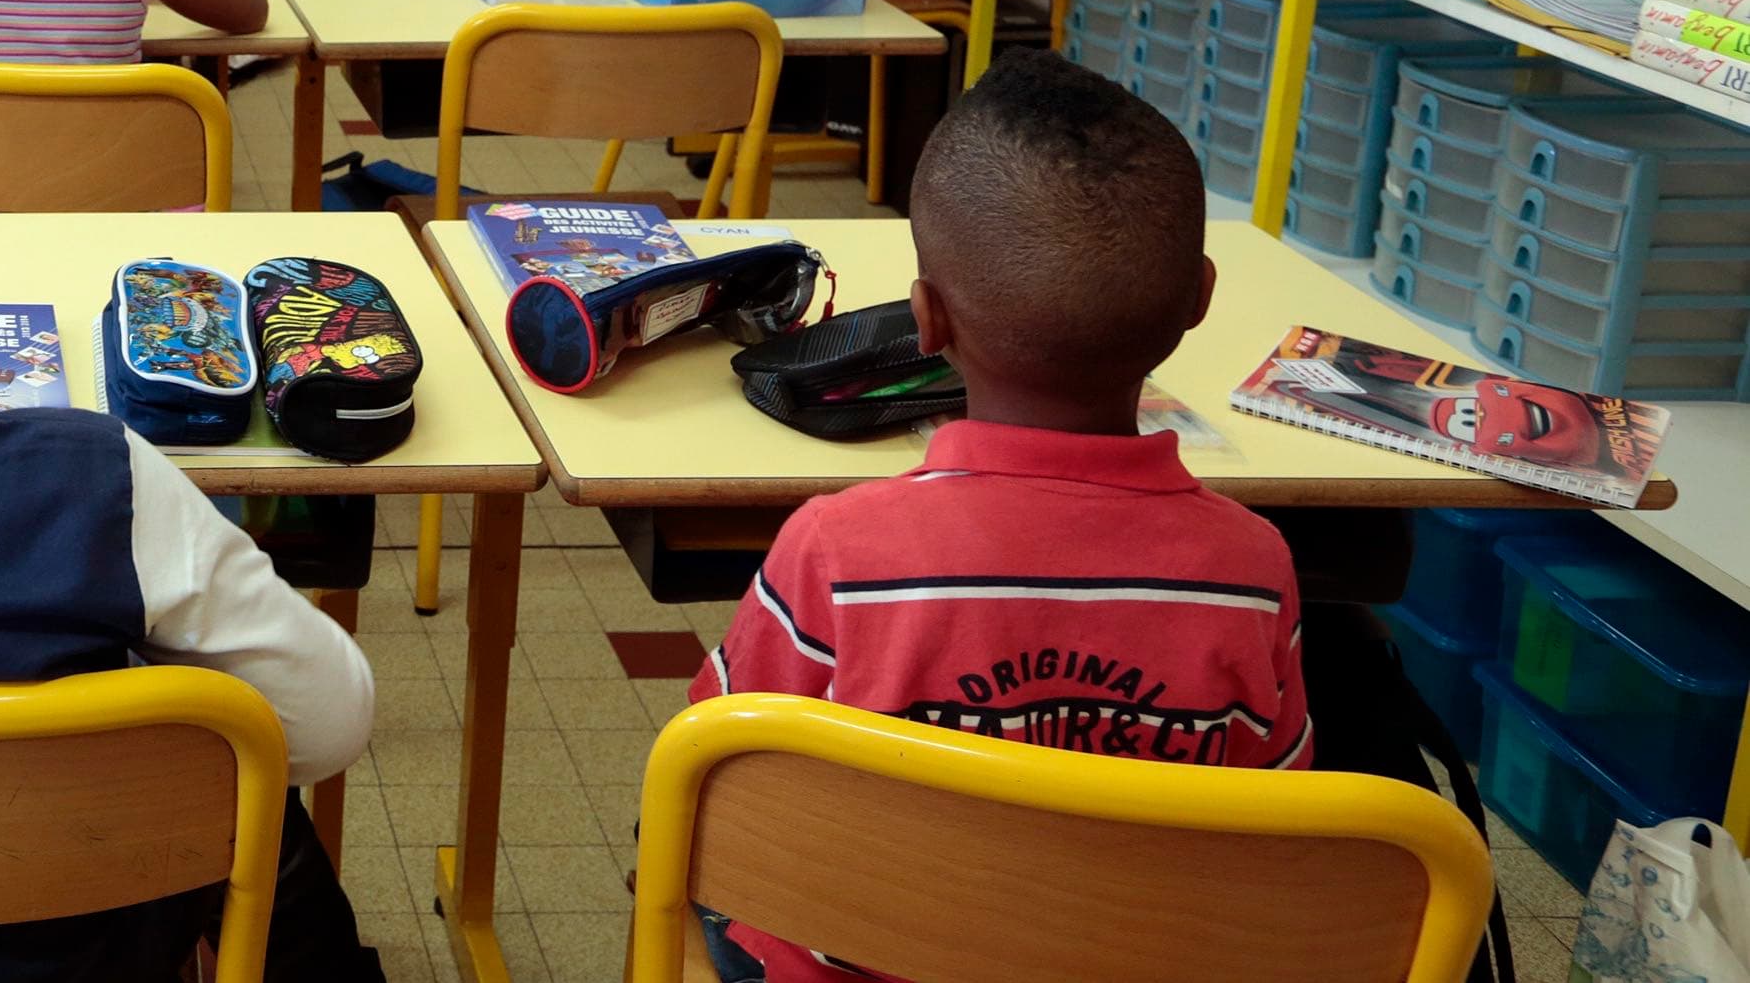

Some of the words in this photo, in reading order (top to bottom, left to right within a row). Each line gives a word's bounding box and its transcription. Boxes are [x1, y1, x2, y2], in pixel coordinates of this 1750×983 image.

[1645, 6, 1735, 52] benjamin
[1637, 40, 1725, 86] benjamin
[538, 207, 634, 222] GUIDE
[549, 225, 646, 237] JEUNESSE
[700, 227, 750, 236] CYAN
[1601, 398, 1628, 431] LINE
[957, 648, 1167, 706] ORIGINAL
